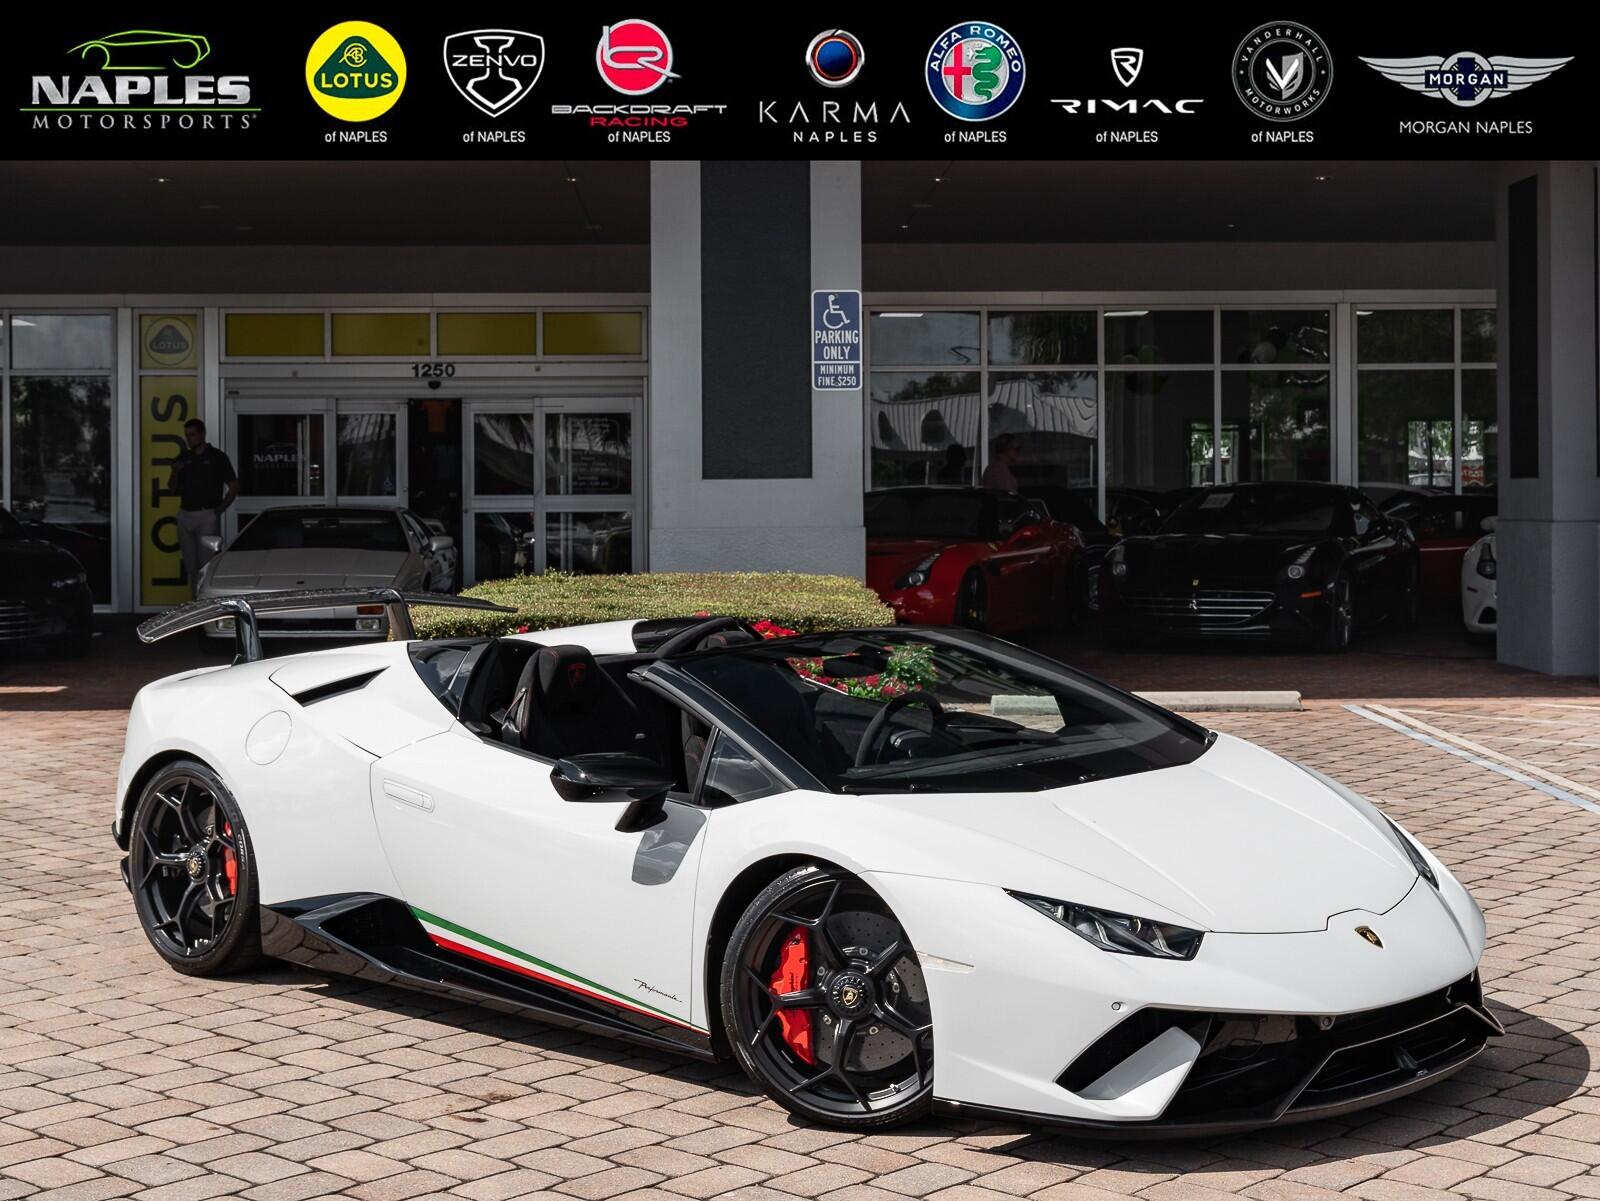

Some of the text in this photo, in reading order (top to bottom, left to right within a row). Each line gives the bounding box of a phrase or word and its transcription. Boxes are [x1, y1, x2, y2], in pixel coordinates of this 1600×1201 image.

[815, 330, 859, 344] PARKING
[152, 341, 187, 350] LOTUS
[823, 346, 851, 360] ONLY
[411, 363, 456, 378] 1250
[820, 364, 855, 375] MINIMUM
[817, 376, 857, 386] FINE $250
[253, 453, 309, 463] NAPLE
